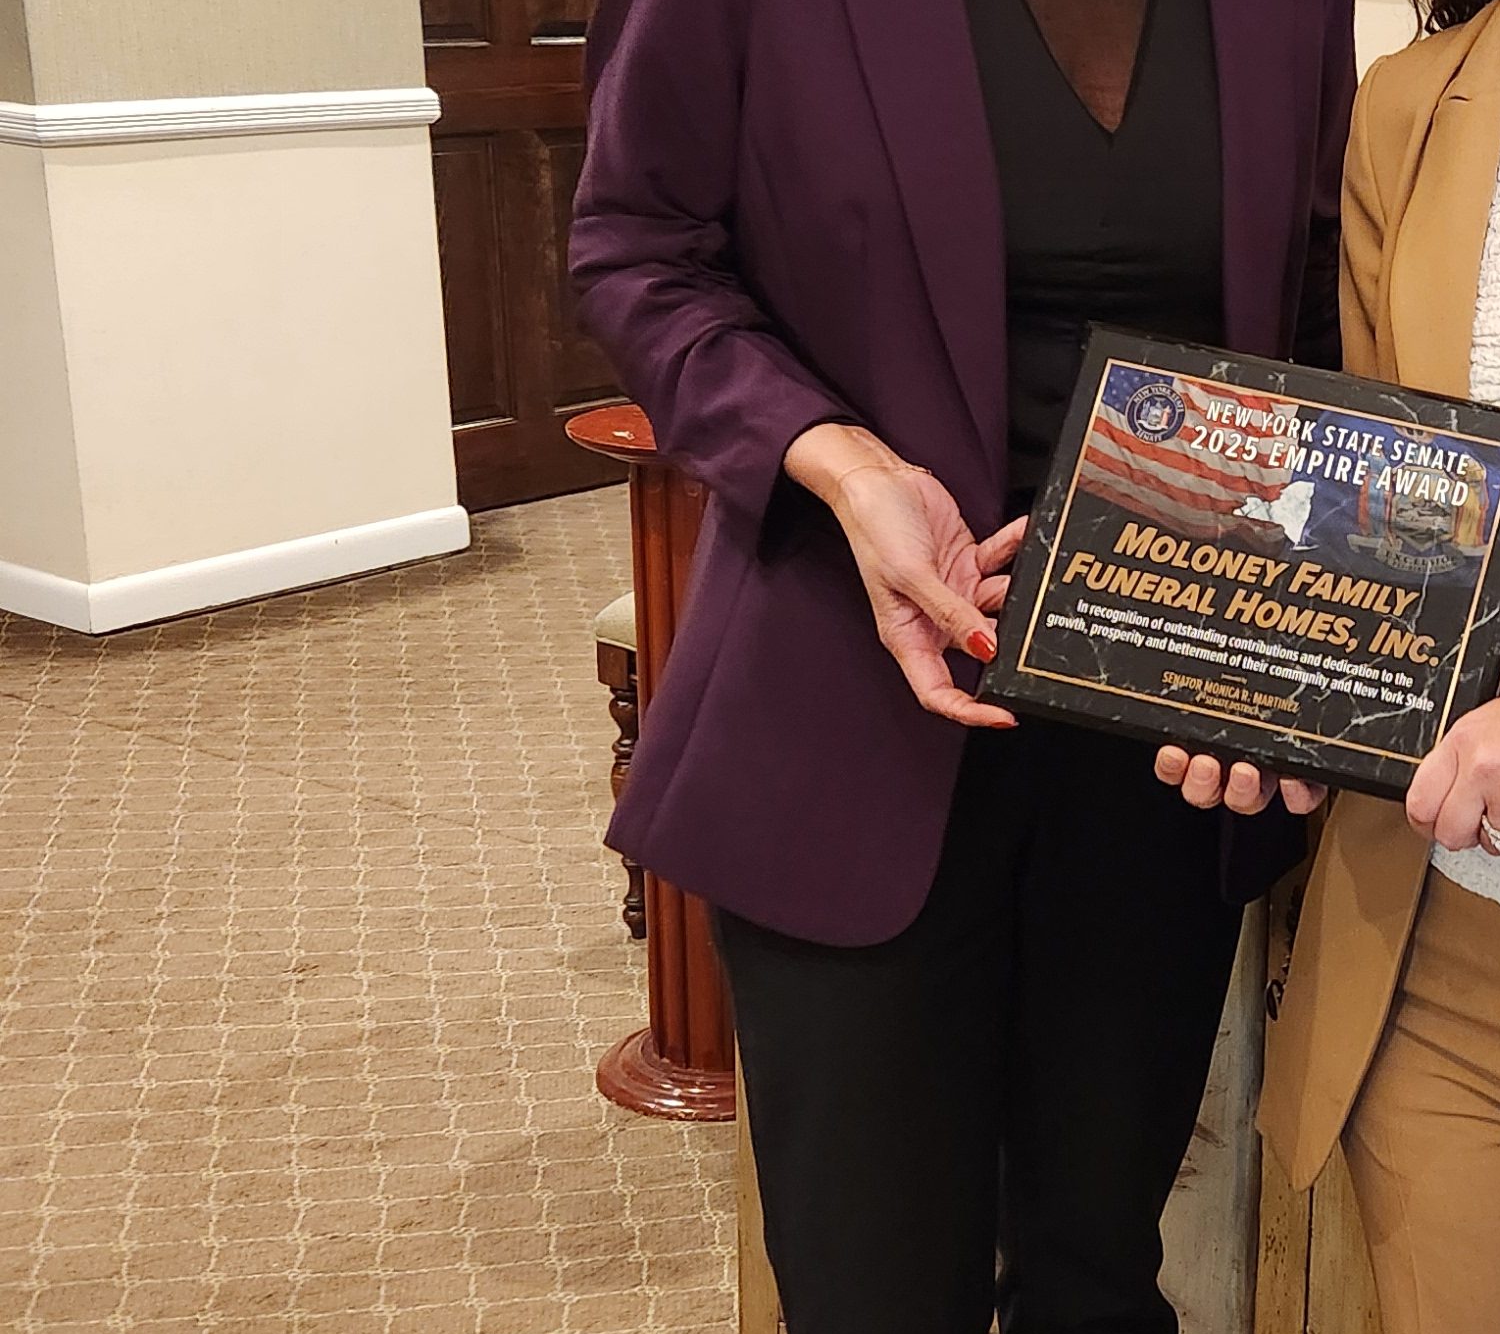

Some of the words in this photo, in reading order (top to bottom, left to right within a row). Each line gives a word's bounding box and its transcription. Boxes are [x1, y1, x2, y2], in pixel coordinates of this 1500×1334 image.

[1190, 425, 1260, 461] 2025
[1268, 442, 1369, 486] EMPIRE
[1375, 466, 1470, 507] AWARD
[1206, 400, 1253, 428] NEW
[1260, 409, 1318, 443] YORK
[1322, 426, 1384, 457] STATE
[1390, 441, 1470, 476] SENATE
[1062, 552, 1217, 616] FUNERAL
[1223, 588, 1360, 654] HOMES,
[1369, 621, 1440, 667] INC.
[1113, 522, 1290, 587] MOLONEY
[1288, 561, 1420, 617] FAMILY
[1046, 613, 1088, 635] growth,
[1089, 622, 1145, 647] prosperity
[1145, 634, 1168, 651] and
[1167, 638, 1228, 664] betterment
[1229, 652, 1242, 668] of
[1242, 656, 1268, 673] their
[1269, 664, 1330, 691] community
[1330, 677, 1351, 693] and
[1353, 681, 1379, 700] New
[1380, 686, 1405, 705] York
[1405, 692, 1435, 712] State
[1077, 599, 1088, 614] In
[1089, 603, 1150, 629] recognition
[1151, 616, 1164, 631] of
[1164, 619, 1228, 649] outstanding
[1228, 636, 1299, 662] contributions
[1300, 651, 1322, 667] and
[1323, 656, 1379, 681] dedication
[1381, 668, 1392, 683] to
[1394, 672, 1414, 688] the
[1161, 670, 1202, 691] SENATOR
[1204, 682, 1240, 700] MONICA
[1241, 689, 1251, 702] R.
[1253, 692, 1300, 714] MARTINEZ
